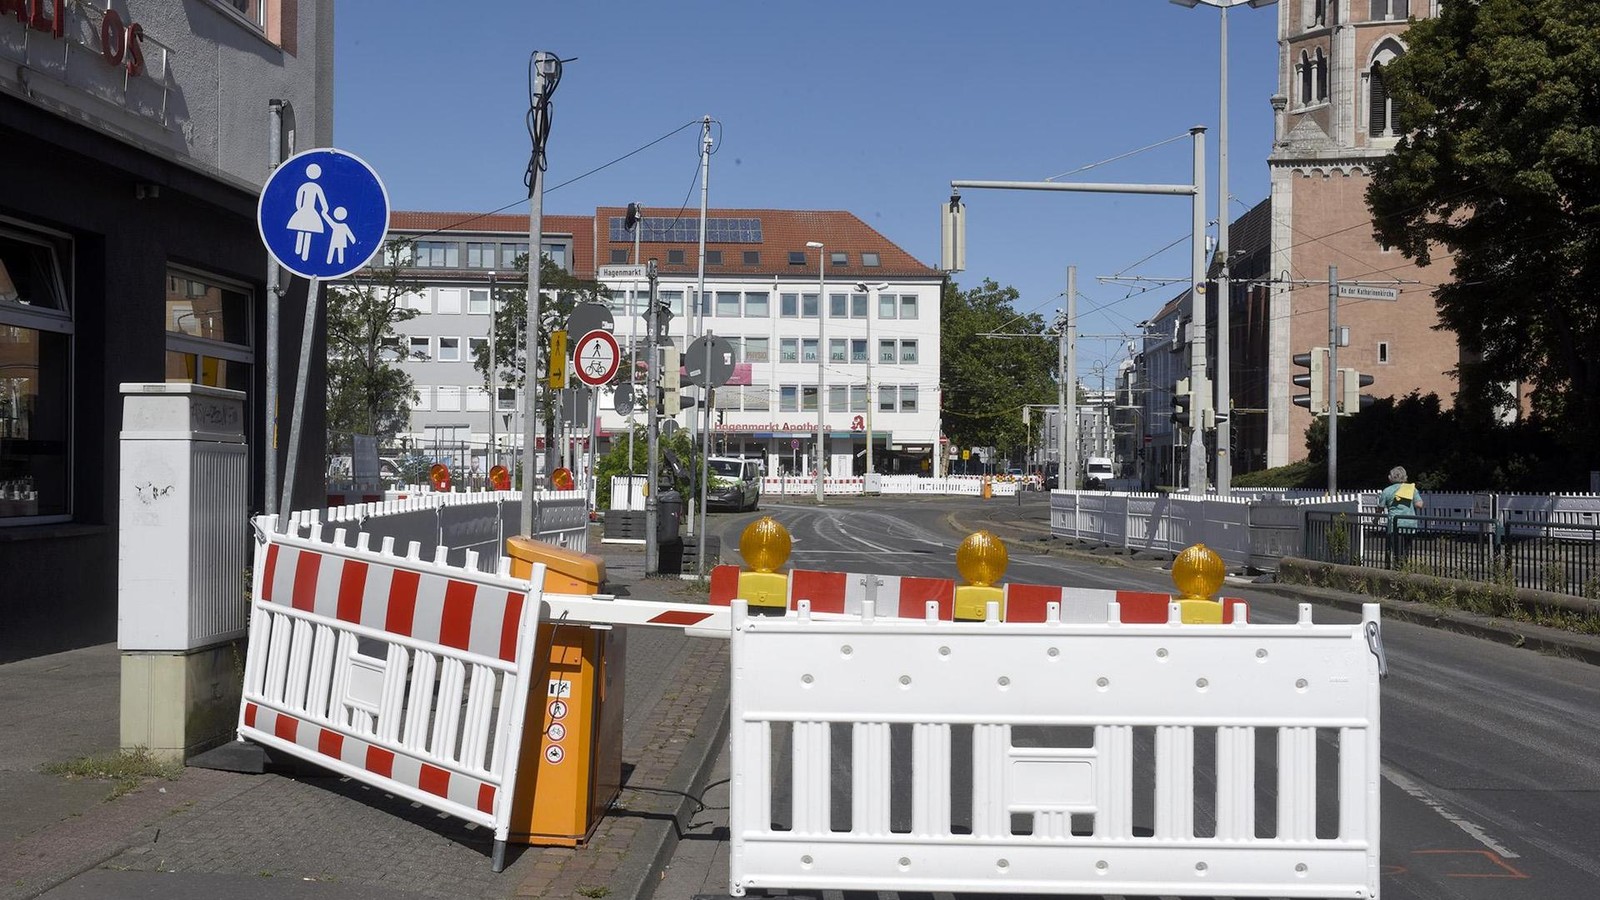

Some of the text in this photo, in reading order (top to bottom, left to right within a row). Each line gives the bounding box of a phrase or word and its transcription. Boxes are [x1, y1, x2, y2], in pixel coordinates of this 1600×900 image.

[604, 269, 641, 277] Hagenmarkt
[1357, 289, 1394, 297] Katharinenkirche
[832, 352, 844, 360] PIE
[714, 422, 779, 432] Hagenmarkt
